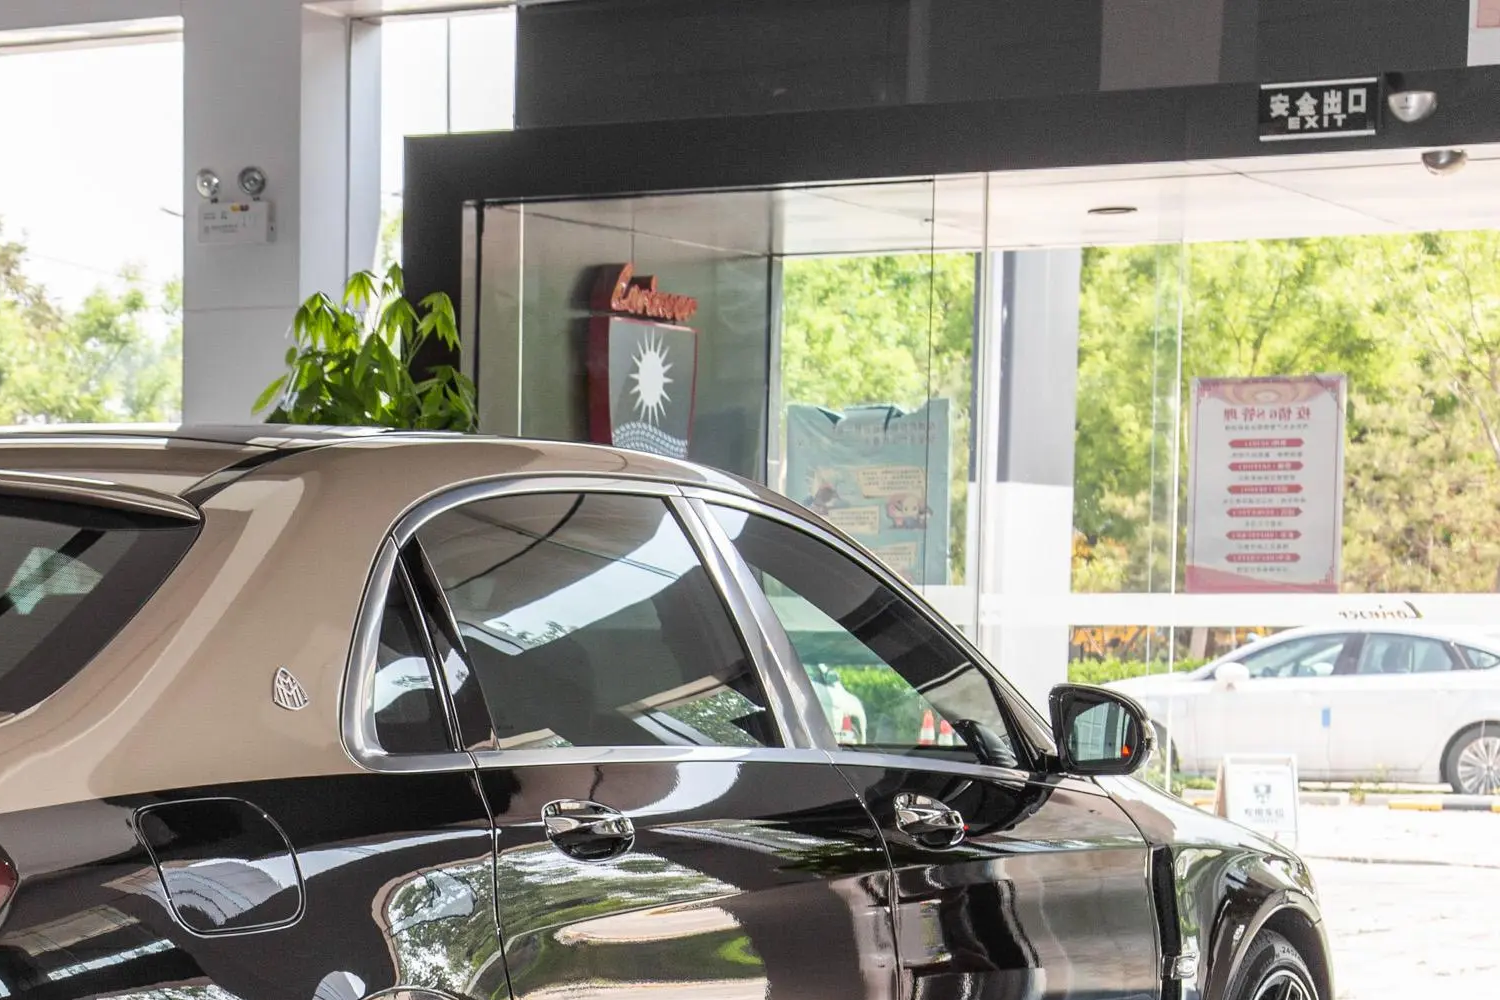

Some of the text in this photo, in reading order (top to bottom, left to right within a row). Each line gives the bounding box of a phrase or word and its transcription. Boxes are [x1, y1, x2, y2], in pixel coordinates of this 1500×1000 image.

[1269, 88, 1367, 117] 安全出口
[1287, 114, 1347, 130] EXIT
